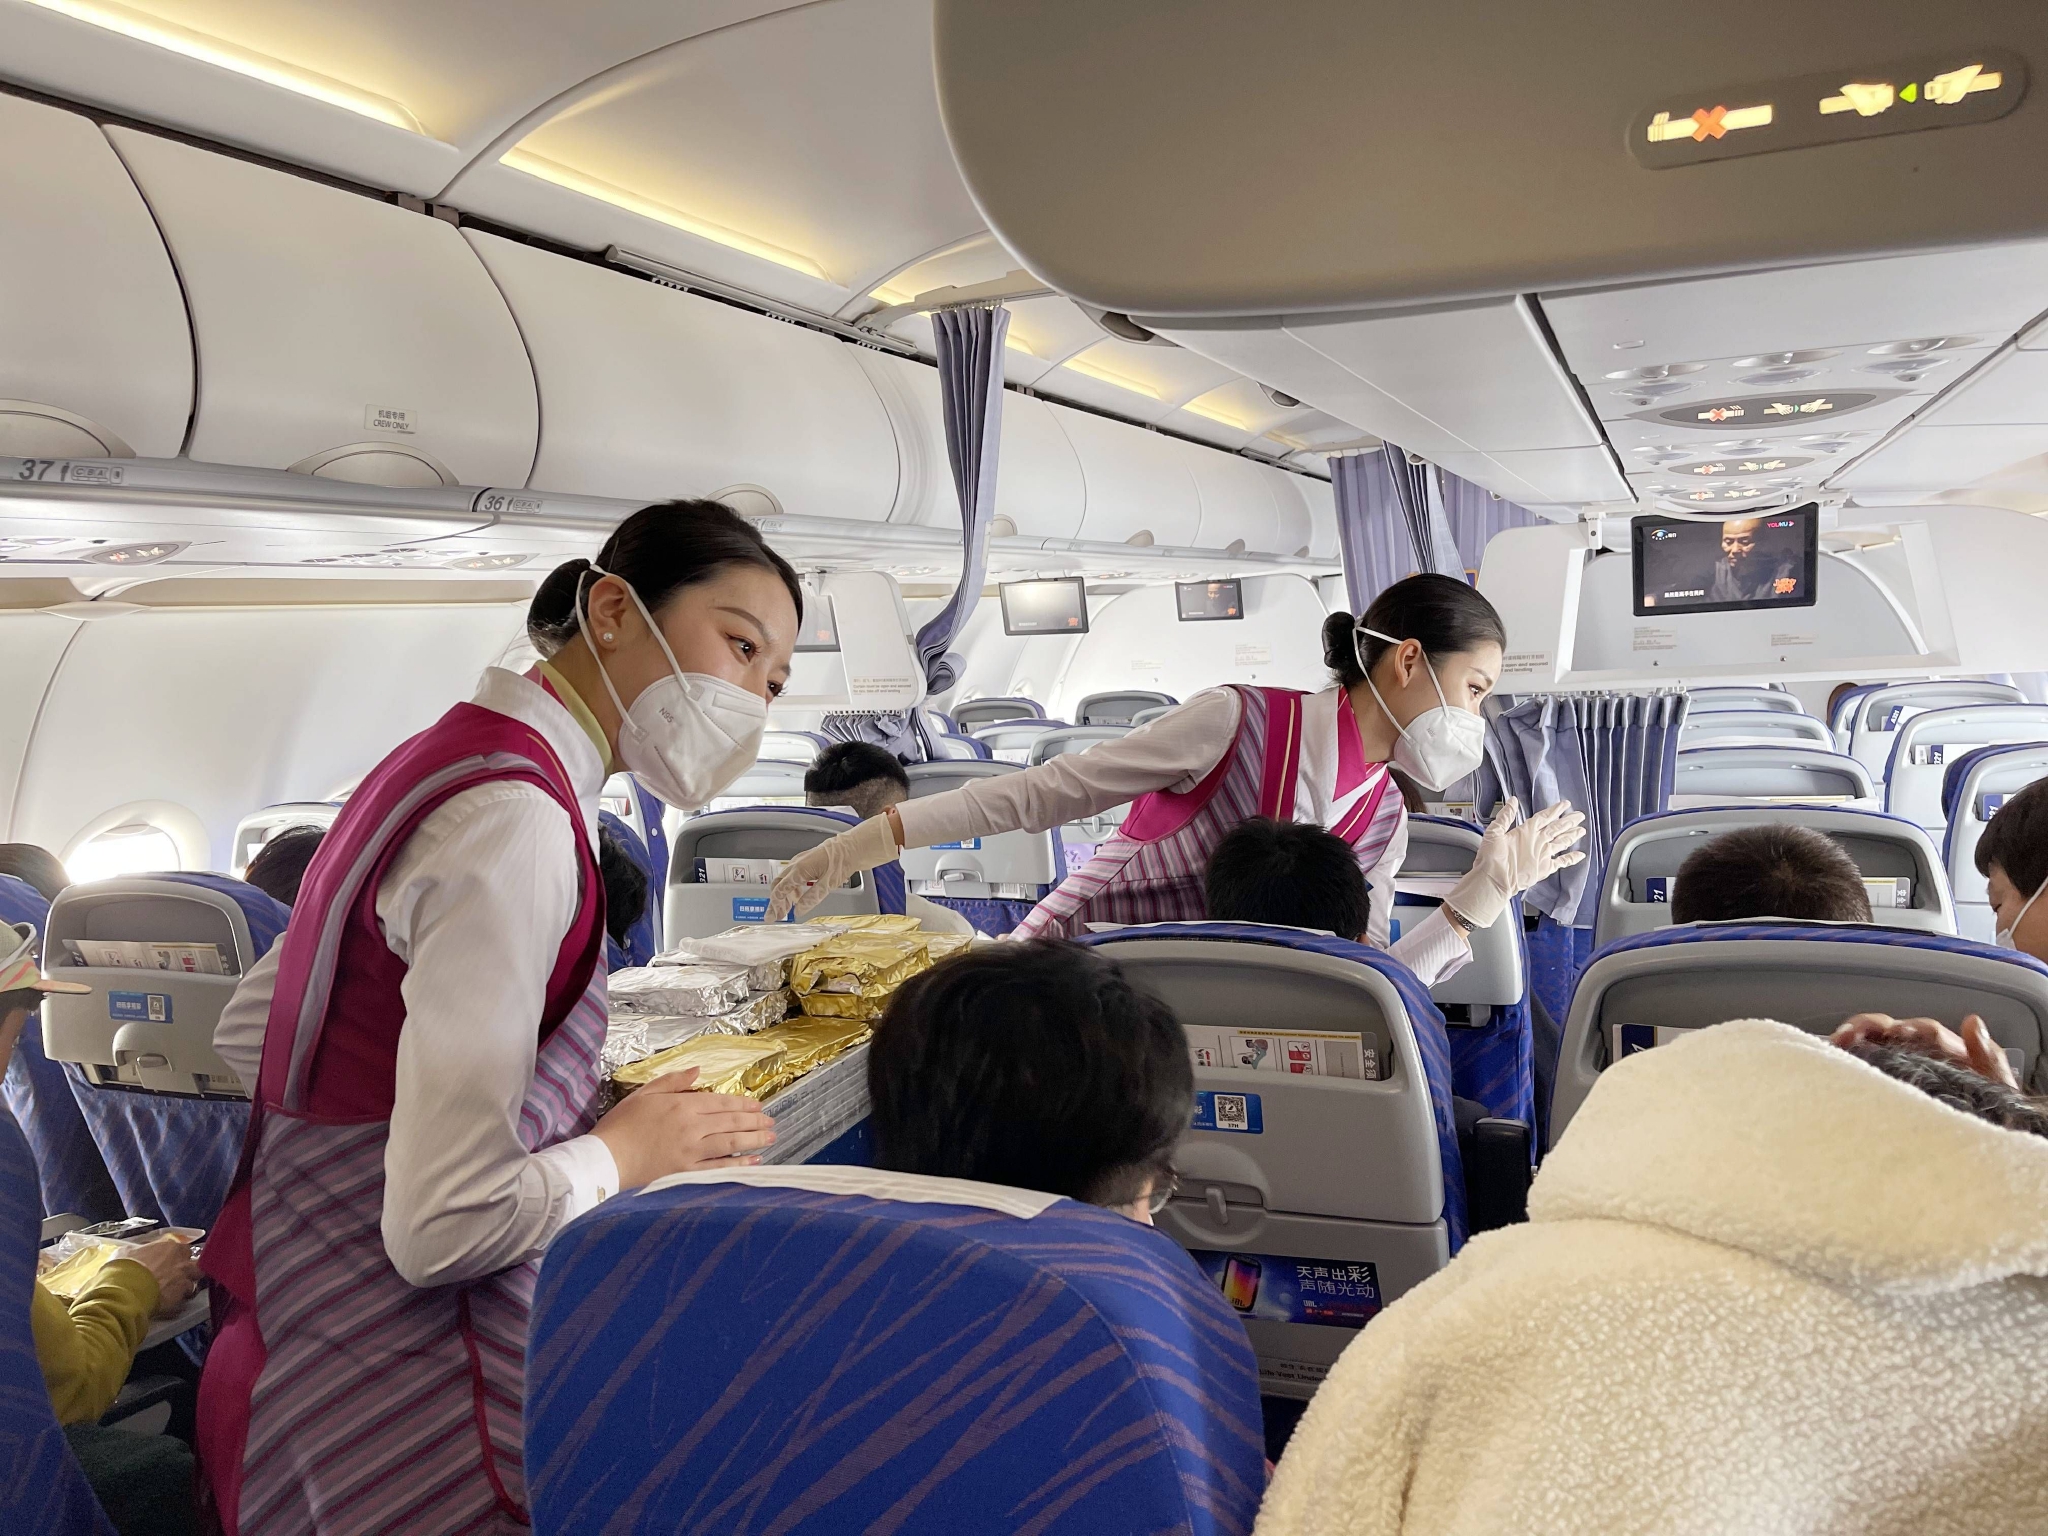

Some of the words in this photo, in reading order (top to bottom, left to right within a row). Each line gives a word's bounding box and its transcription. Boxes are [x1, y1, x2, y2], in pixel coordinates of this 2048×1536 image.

[378, 410, 406, 421] 机组专用
[373, 419, 391, 428] CREW
[392, 421, 410, 430] ONLY
[19, 459, 55, 480] 37
[484, 496, 505, 511] 36
[658, 708, 674, 723] N95
[1296, 1265, 1371, 1283] 天声出彩
[1298, 1279, 1375, 1299] 声随光动
